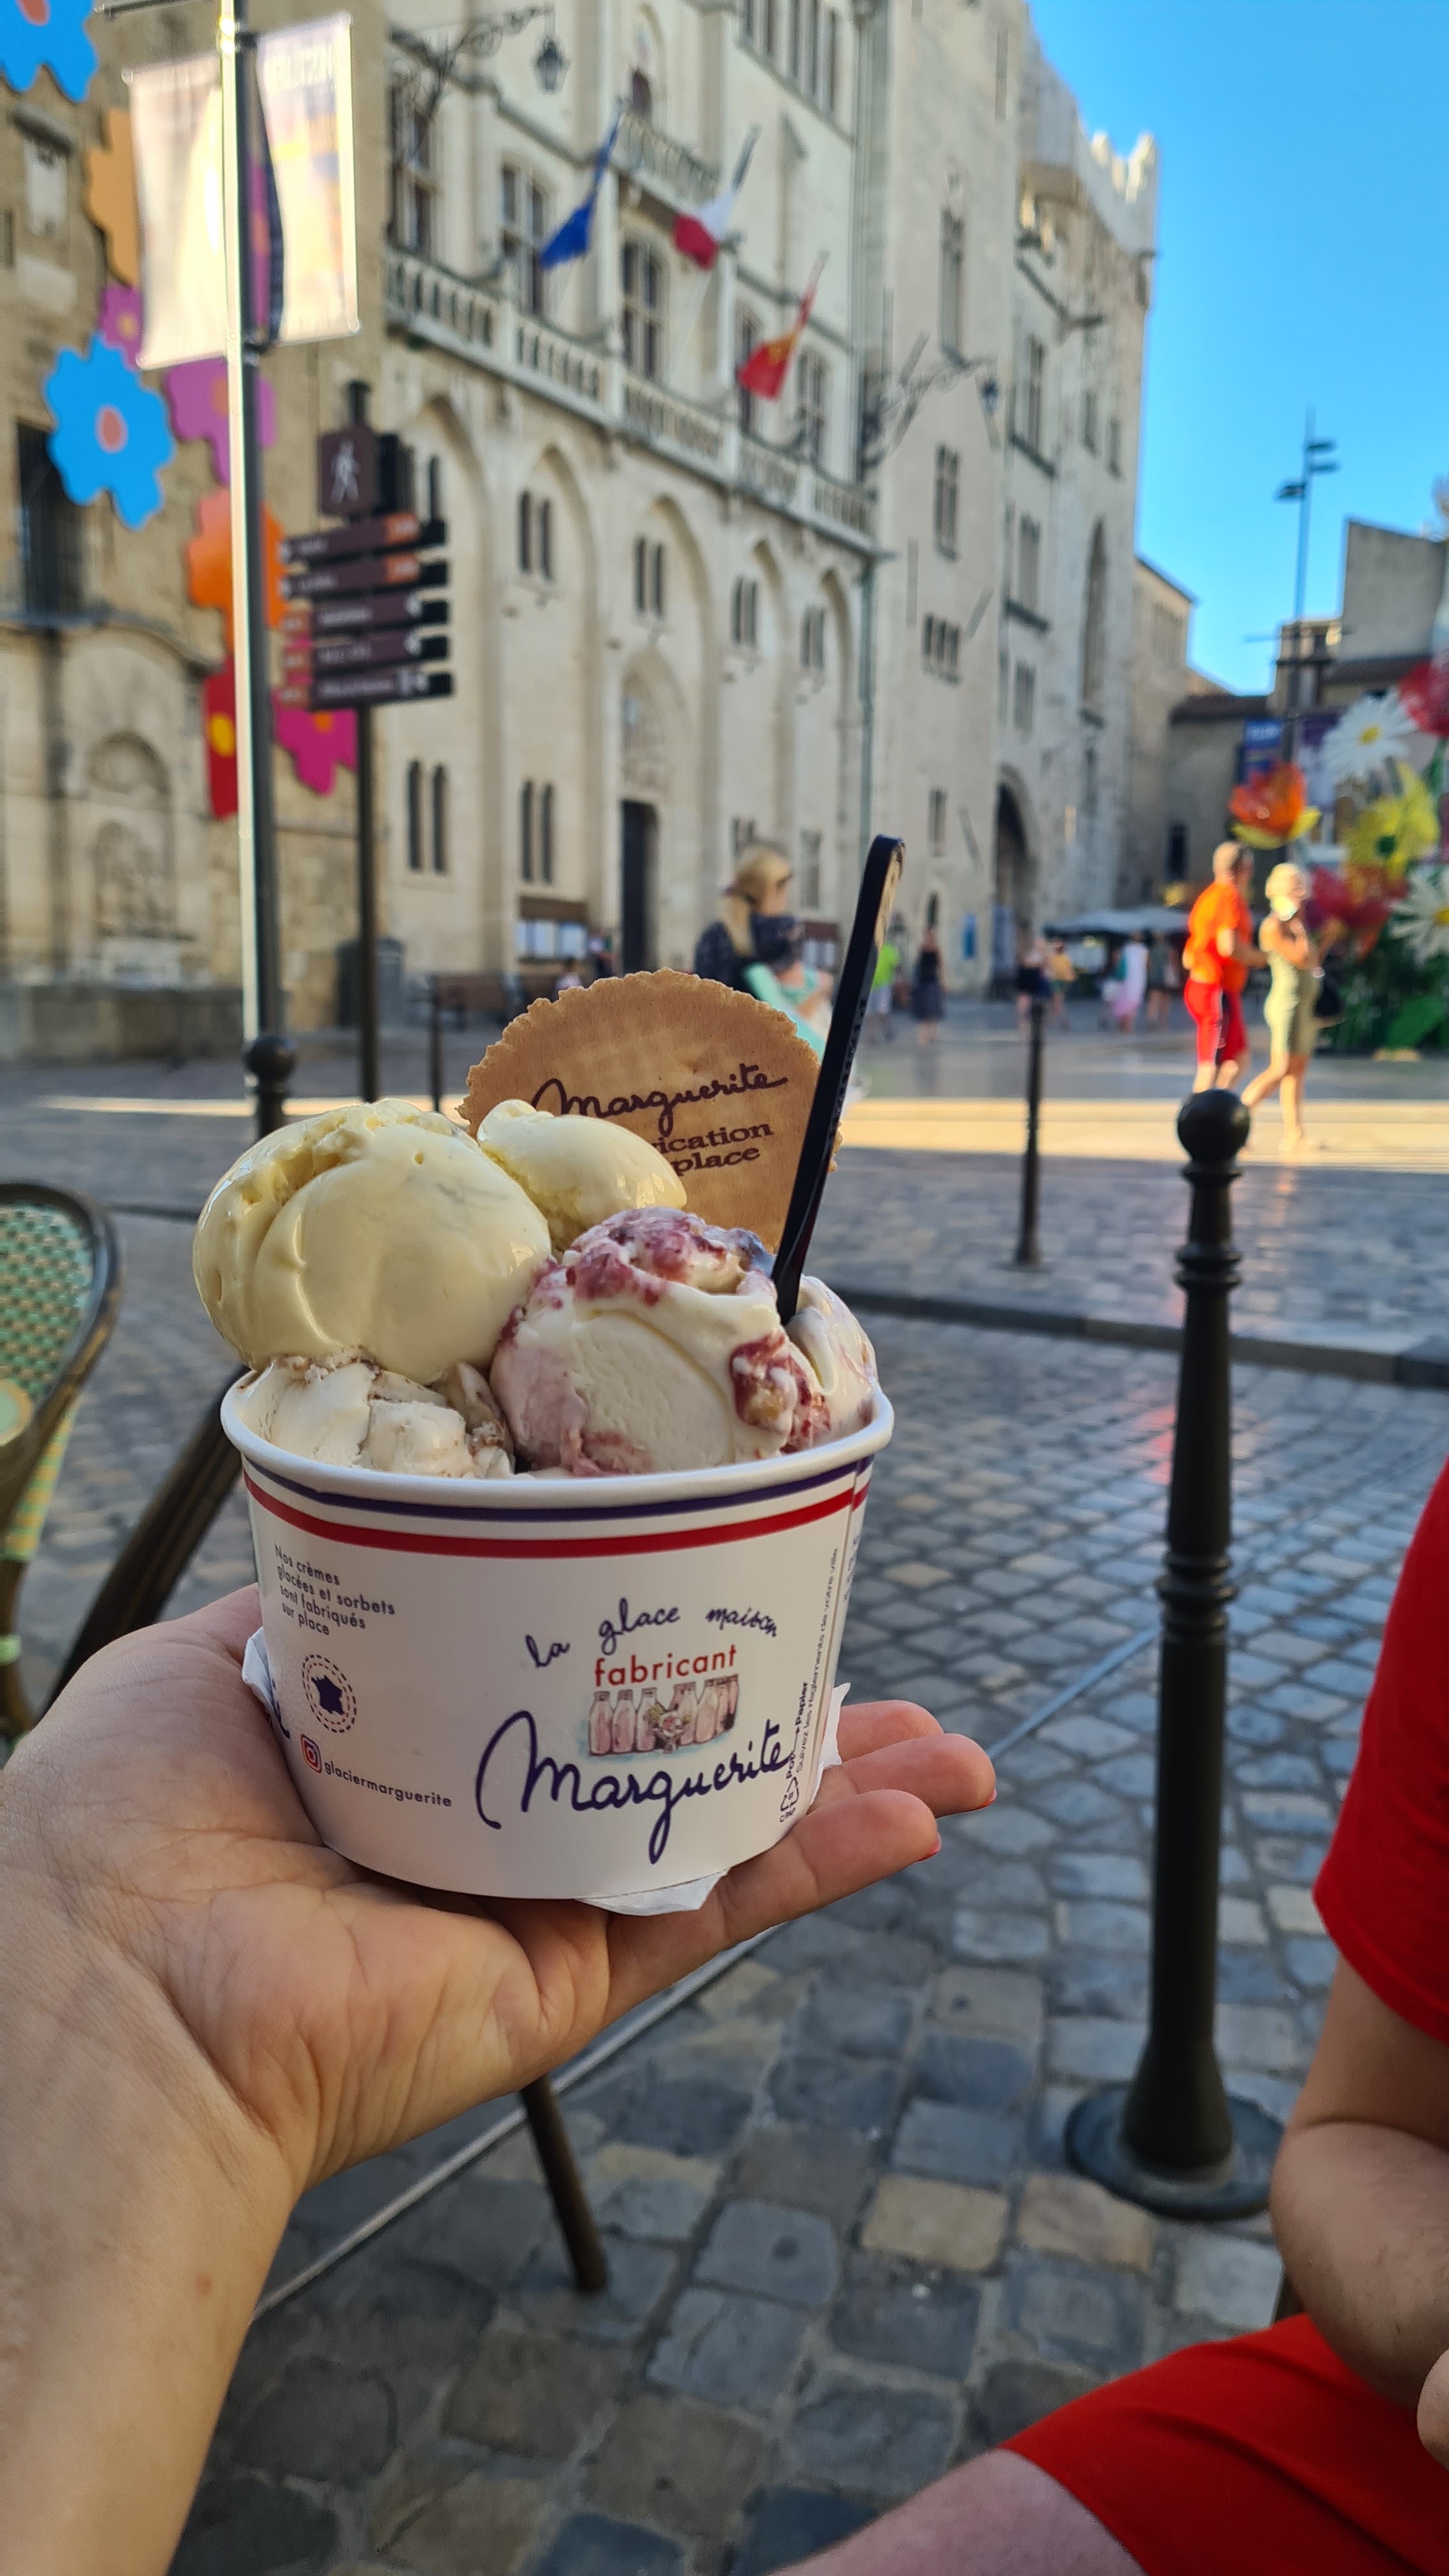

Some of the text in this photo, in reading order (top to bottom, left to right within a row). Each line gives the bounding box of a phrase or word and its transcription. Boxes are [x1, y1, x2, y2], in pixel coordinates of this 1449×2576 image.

[530, 1062, 788, 1135] Marguerite
[670, 1147, 761, 1176] place
[274, 1542, 340, 1586] Nos crèmes
[277, 1563, 395, 1614] glacées et sorbets
[280, 1585, 366, 1629] sont fabriqués
[282, 1602, 330, 1636] sur place
[525, 1597, 777, 1668] la glace maison
[594, 1644, 737, 1687] fabricant
[325, 1761, 452, 1807] glaciermarguerite
[475, 1710, 793, 1864] Marguerite
